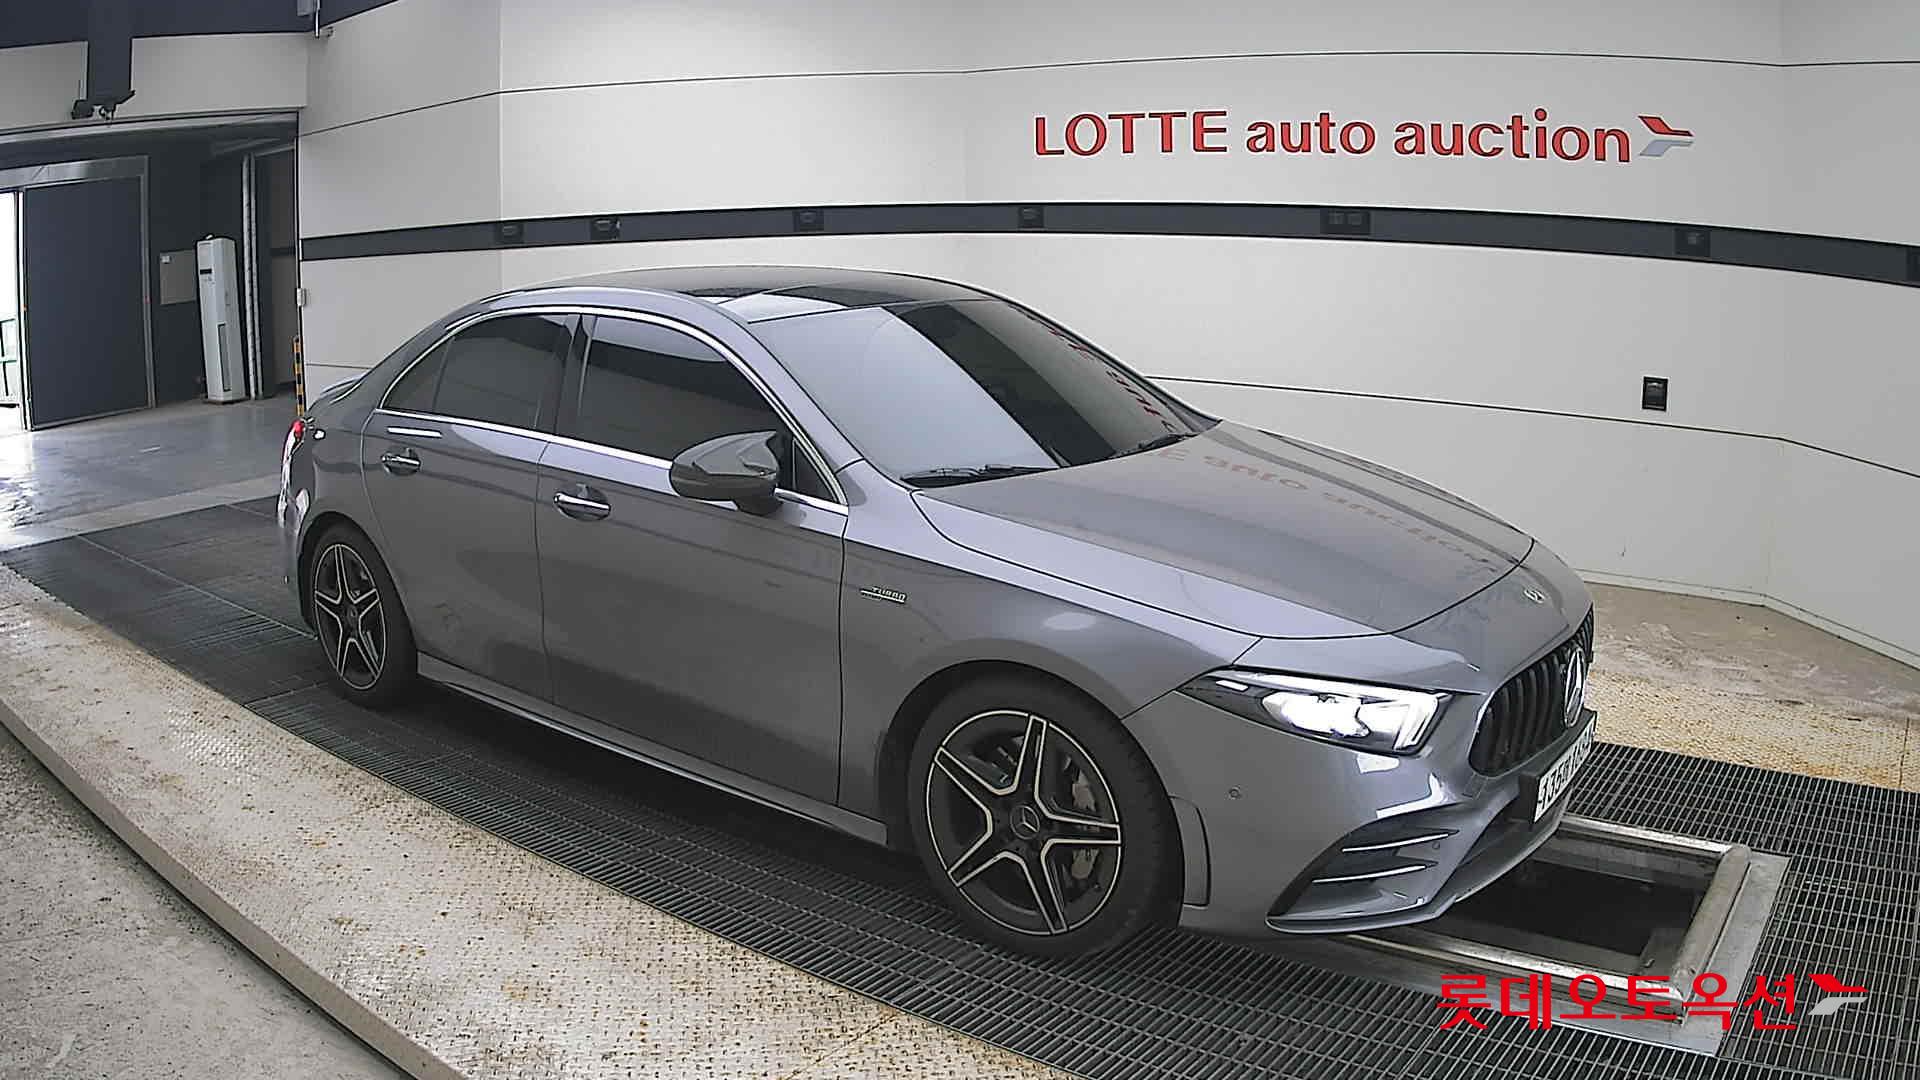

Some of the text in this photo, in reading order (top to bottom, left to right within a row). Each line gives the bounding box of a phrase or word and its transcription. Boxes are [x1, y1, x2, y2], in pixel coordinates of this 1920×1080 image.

[1034, 107, 1630, 163] LOTTE auto auction
